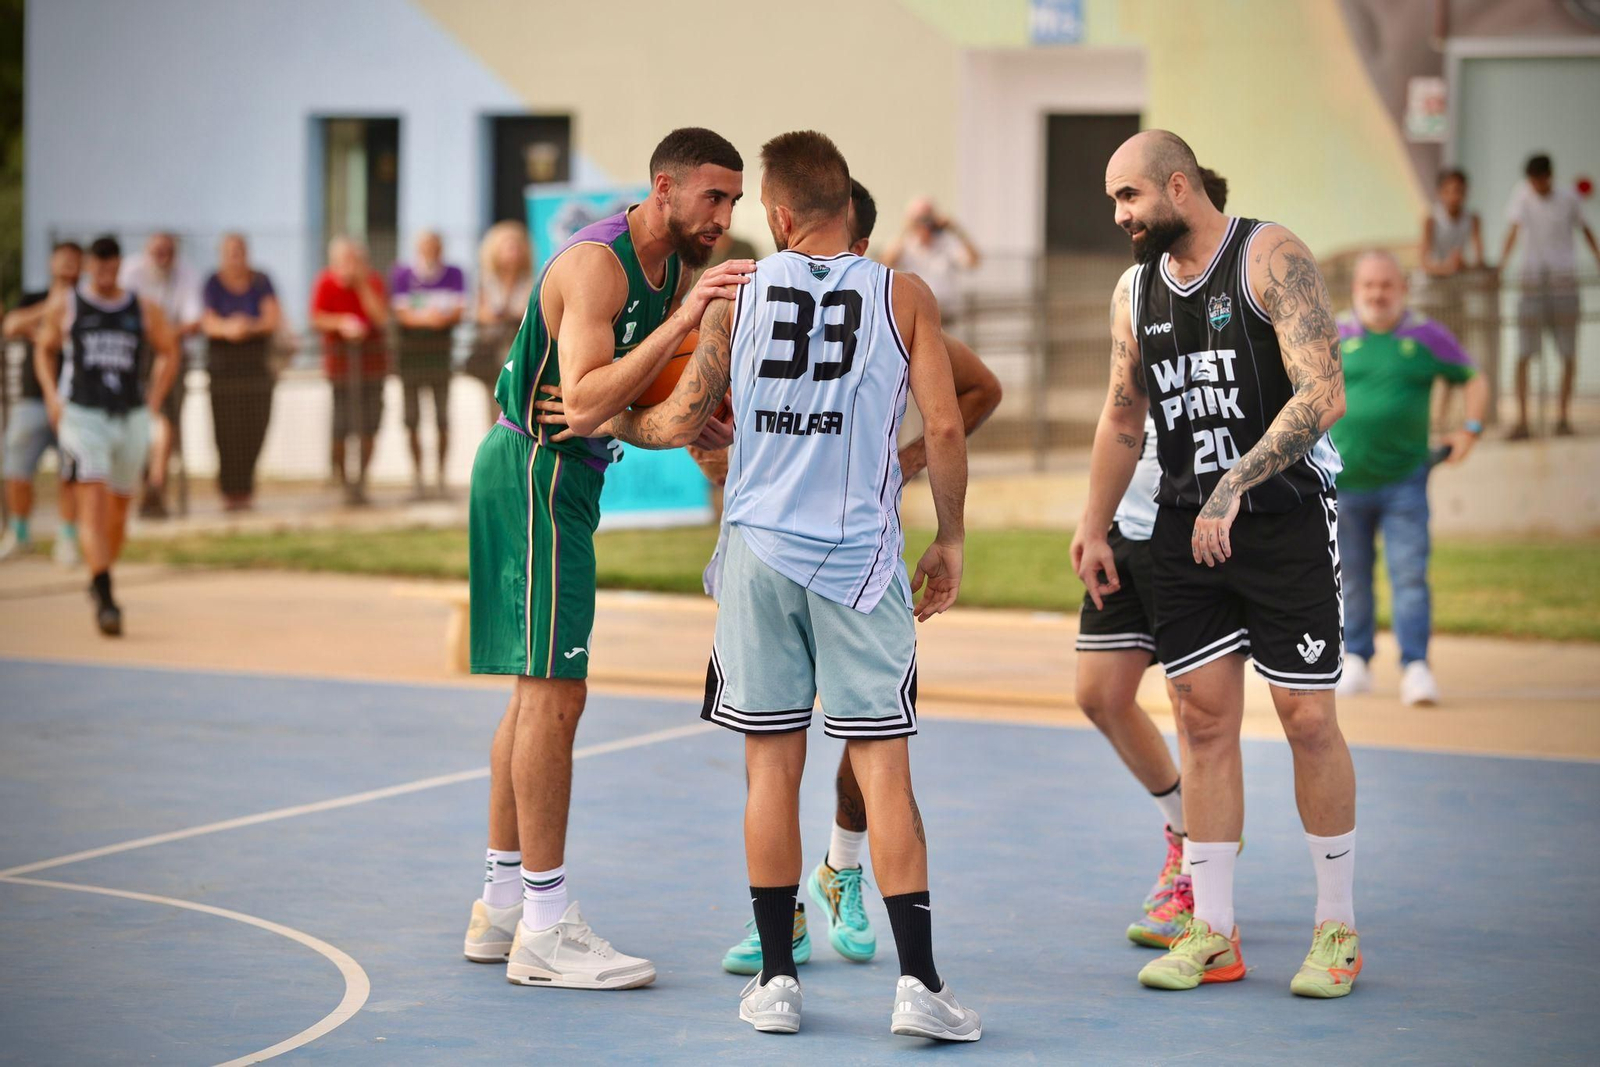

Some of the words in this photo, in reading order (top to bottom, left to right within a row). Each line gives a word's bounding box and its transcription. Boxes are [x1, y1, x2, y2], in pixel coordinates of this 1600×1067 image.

[757, 285, 863, 382] 33
[1144, 322, 1172, 336] vive
[1192, 426, 1242, 475] 20
